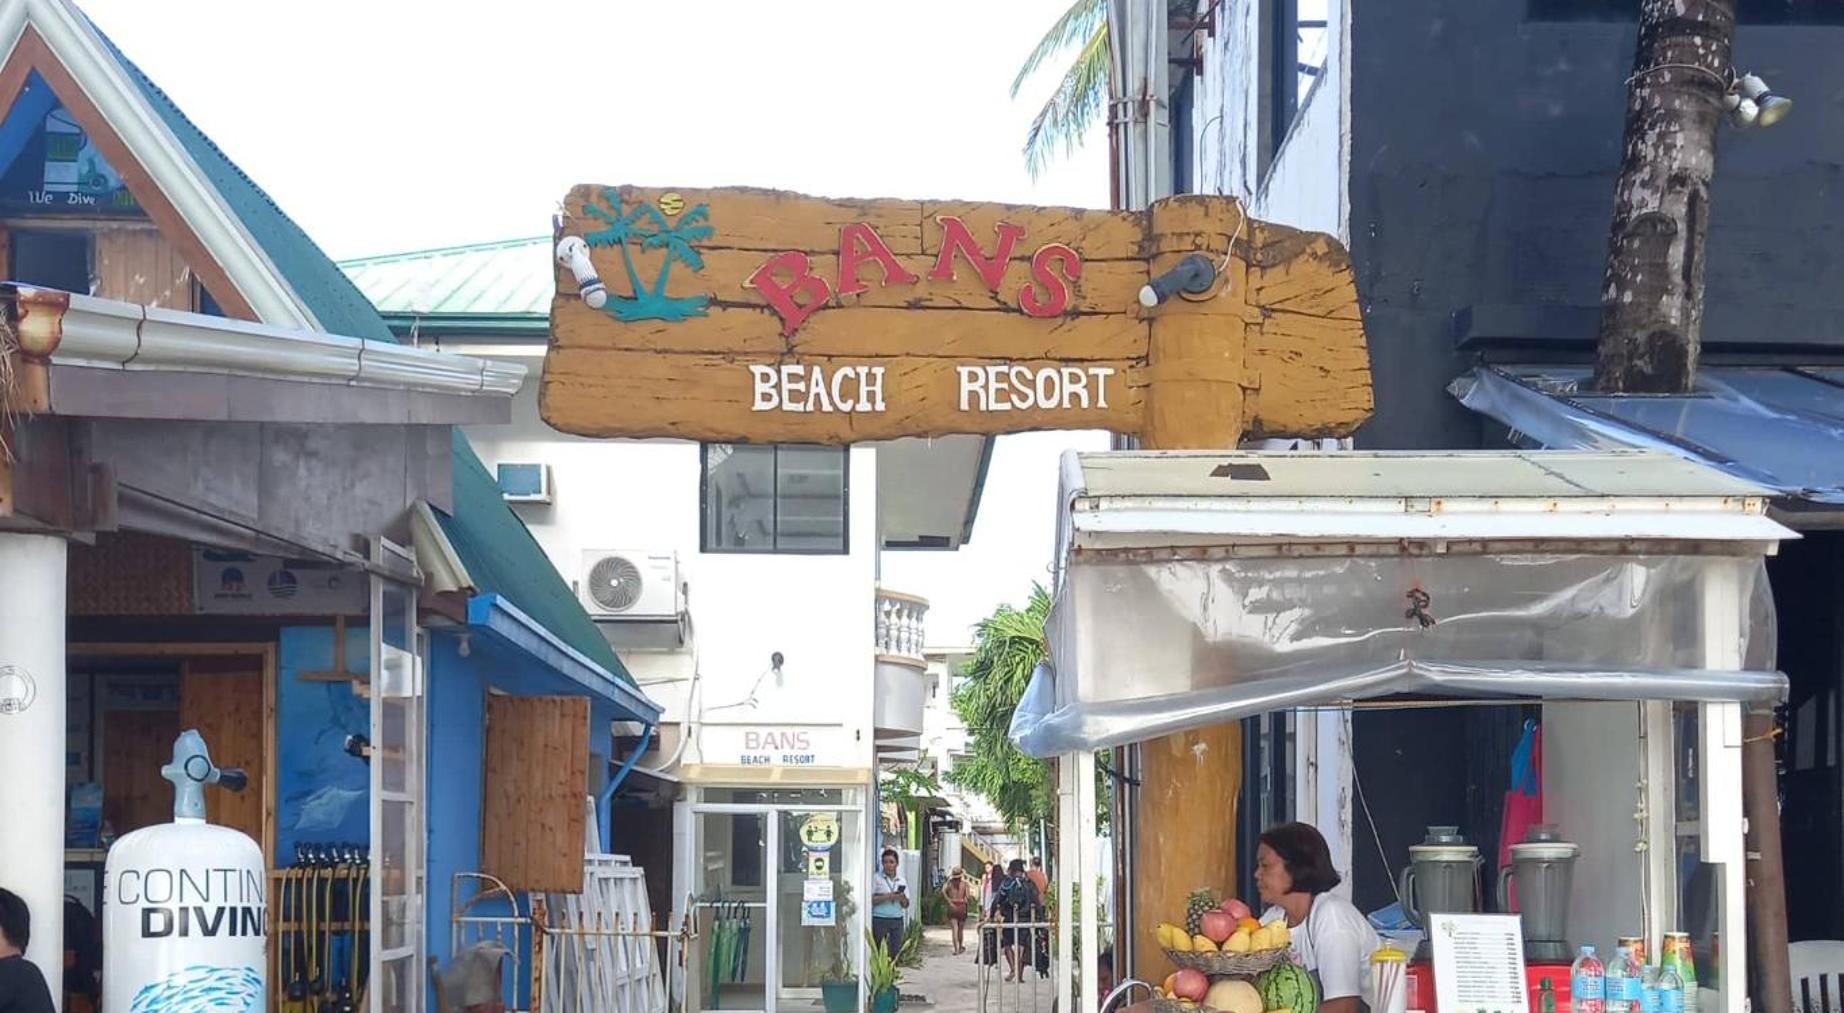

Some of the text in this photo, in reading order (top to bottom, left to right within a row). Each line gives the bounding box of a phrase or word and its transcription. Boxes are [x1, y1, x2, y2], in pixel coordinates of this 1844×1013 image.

[742, 215, 1082, 335] BANS
[749, 365, 1114, 412] BEACH RESORT
[745, 732, 810, 750] BANS
[741, 755, 815, 764] BEACH RESORT
